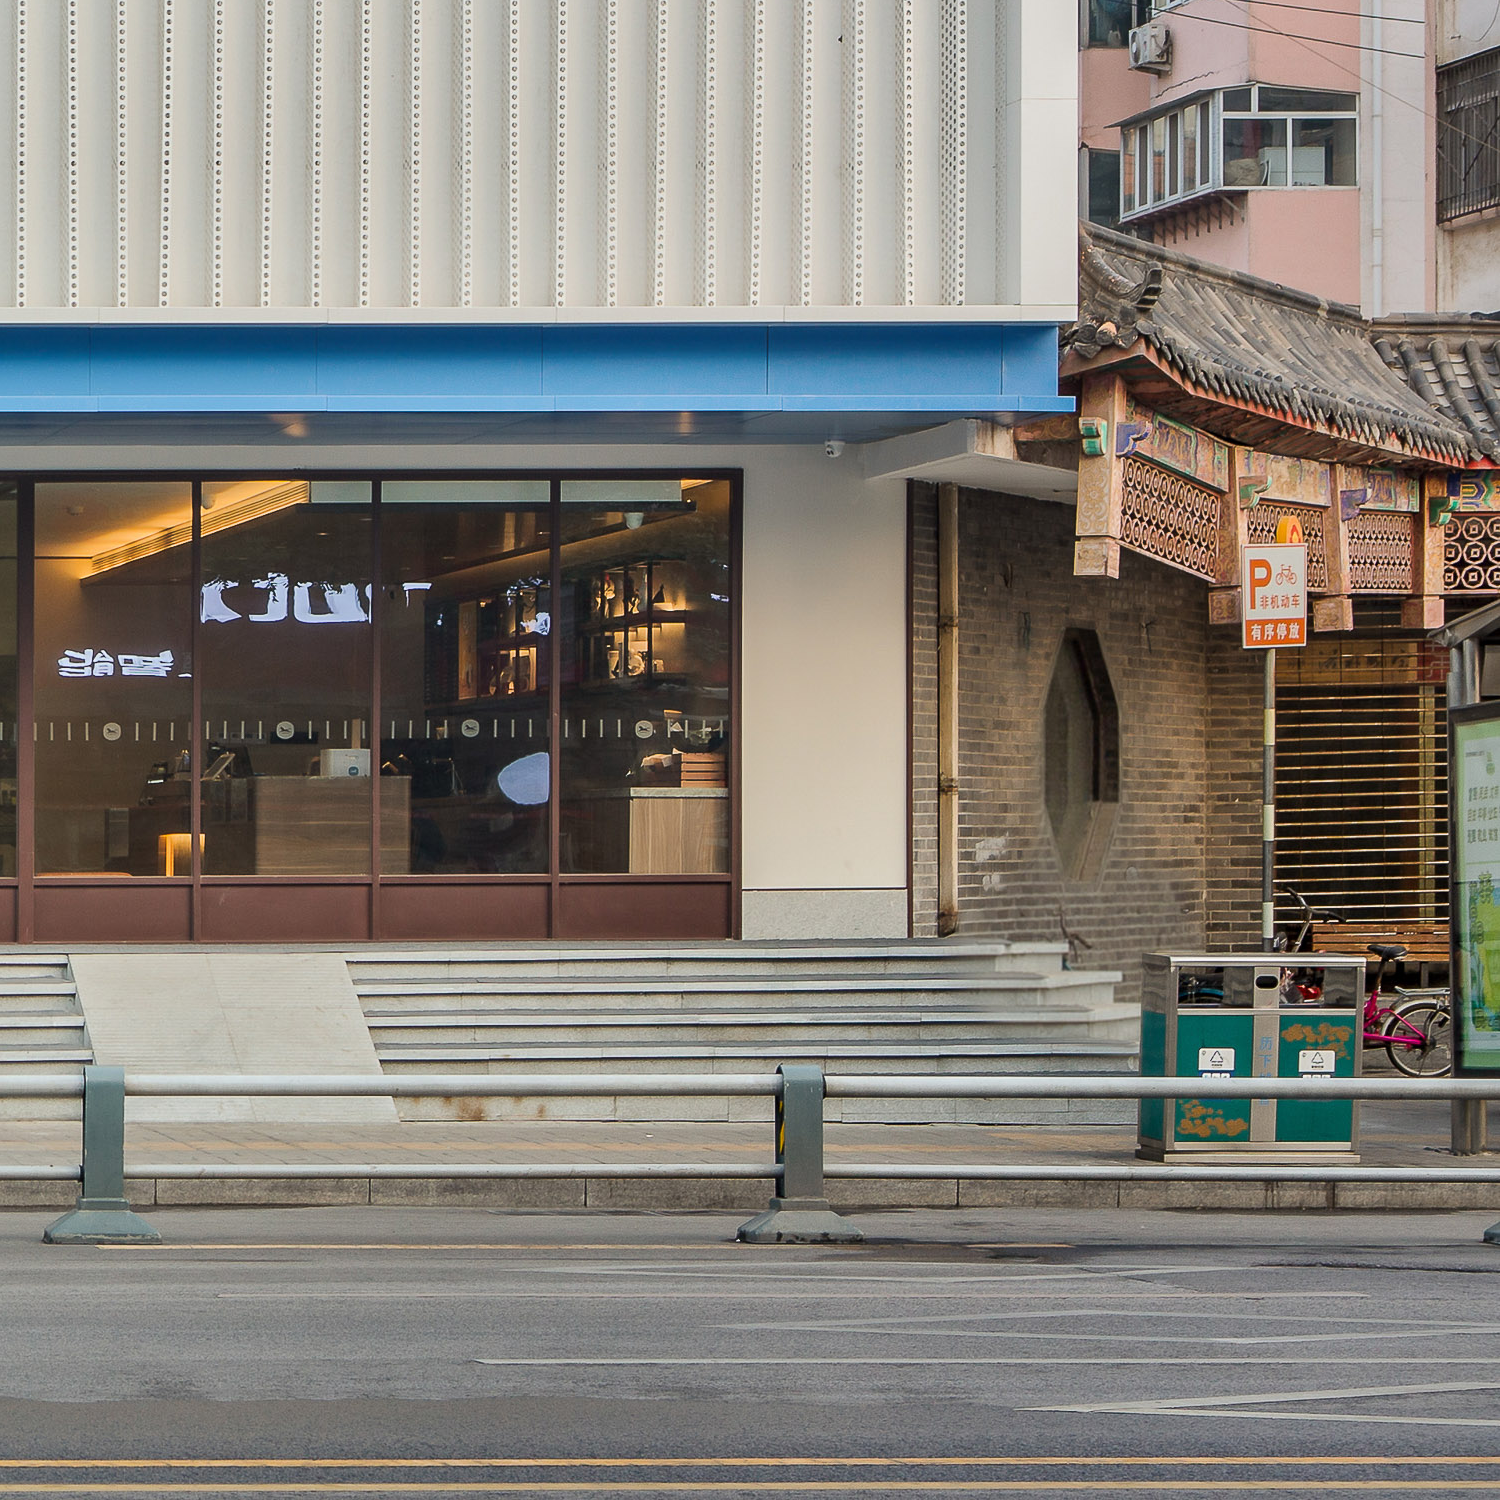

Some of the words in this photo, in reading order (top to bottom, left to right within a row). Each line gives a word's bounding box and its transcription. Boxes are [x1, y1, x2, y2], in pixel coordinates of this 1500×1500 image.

[1249, 558, 1272, 610] P
[1259, 594, 1301, 610] 非机动车
[1250, 622, 1300, 642] 有序停放
